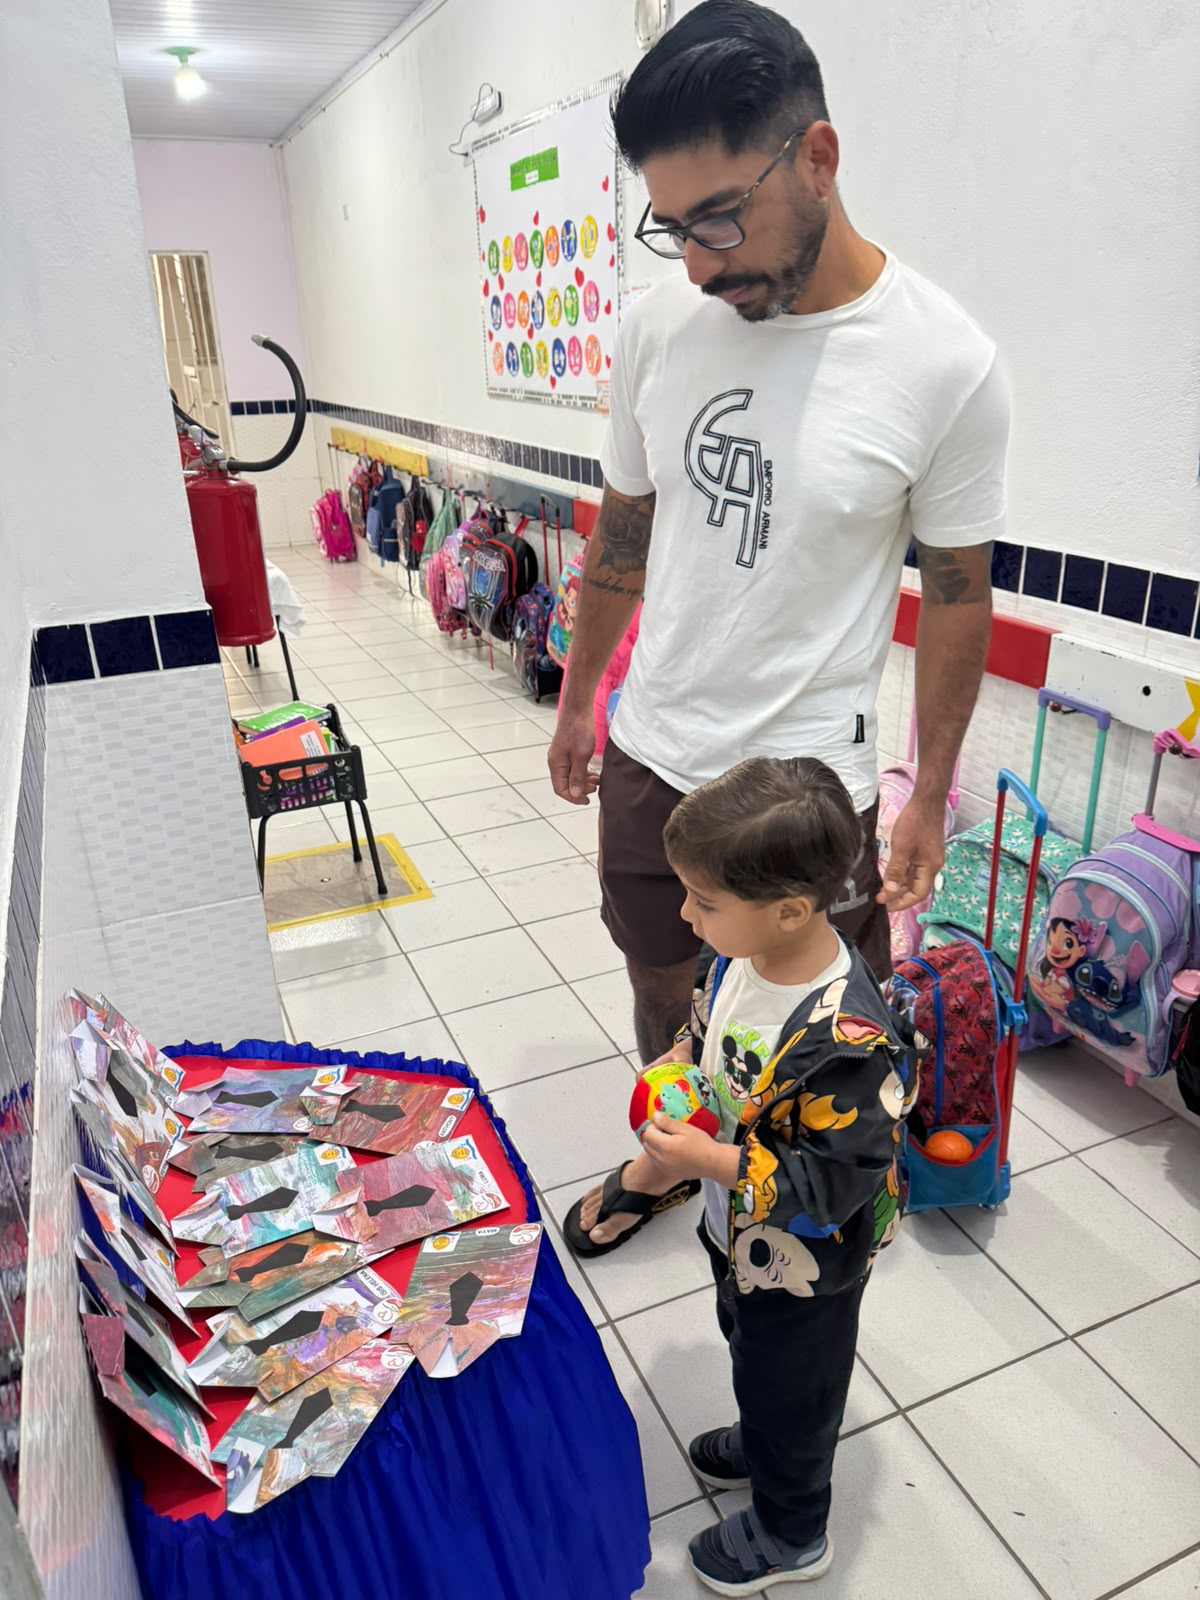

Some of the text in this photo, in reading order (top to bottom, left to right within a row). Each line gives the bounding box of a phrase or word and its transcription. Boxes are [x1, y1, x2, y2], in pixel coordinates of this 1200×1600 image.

[758, 459, 773, 550] EMPORIO ARMANI
[360, 1270, 379, 1288] HELENA
